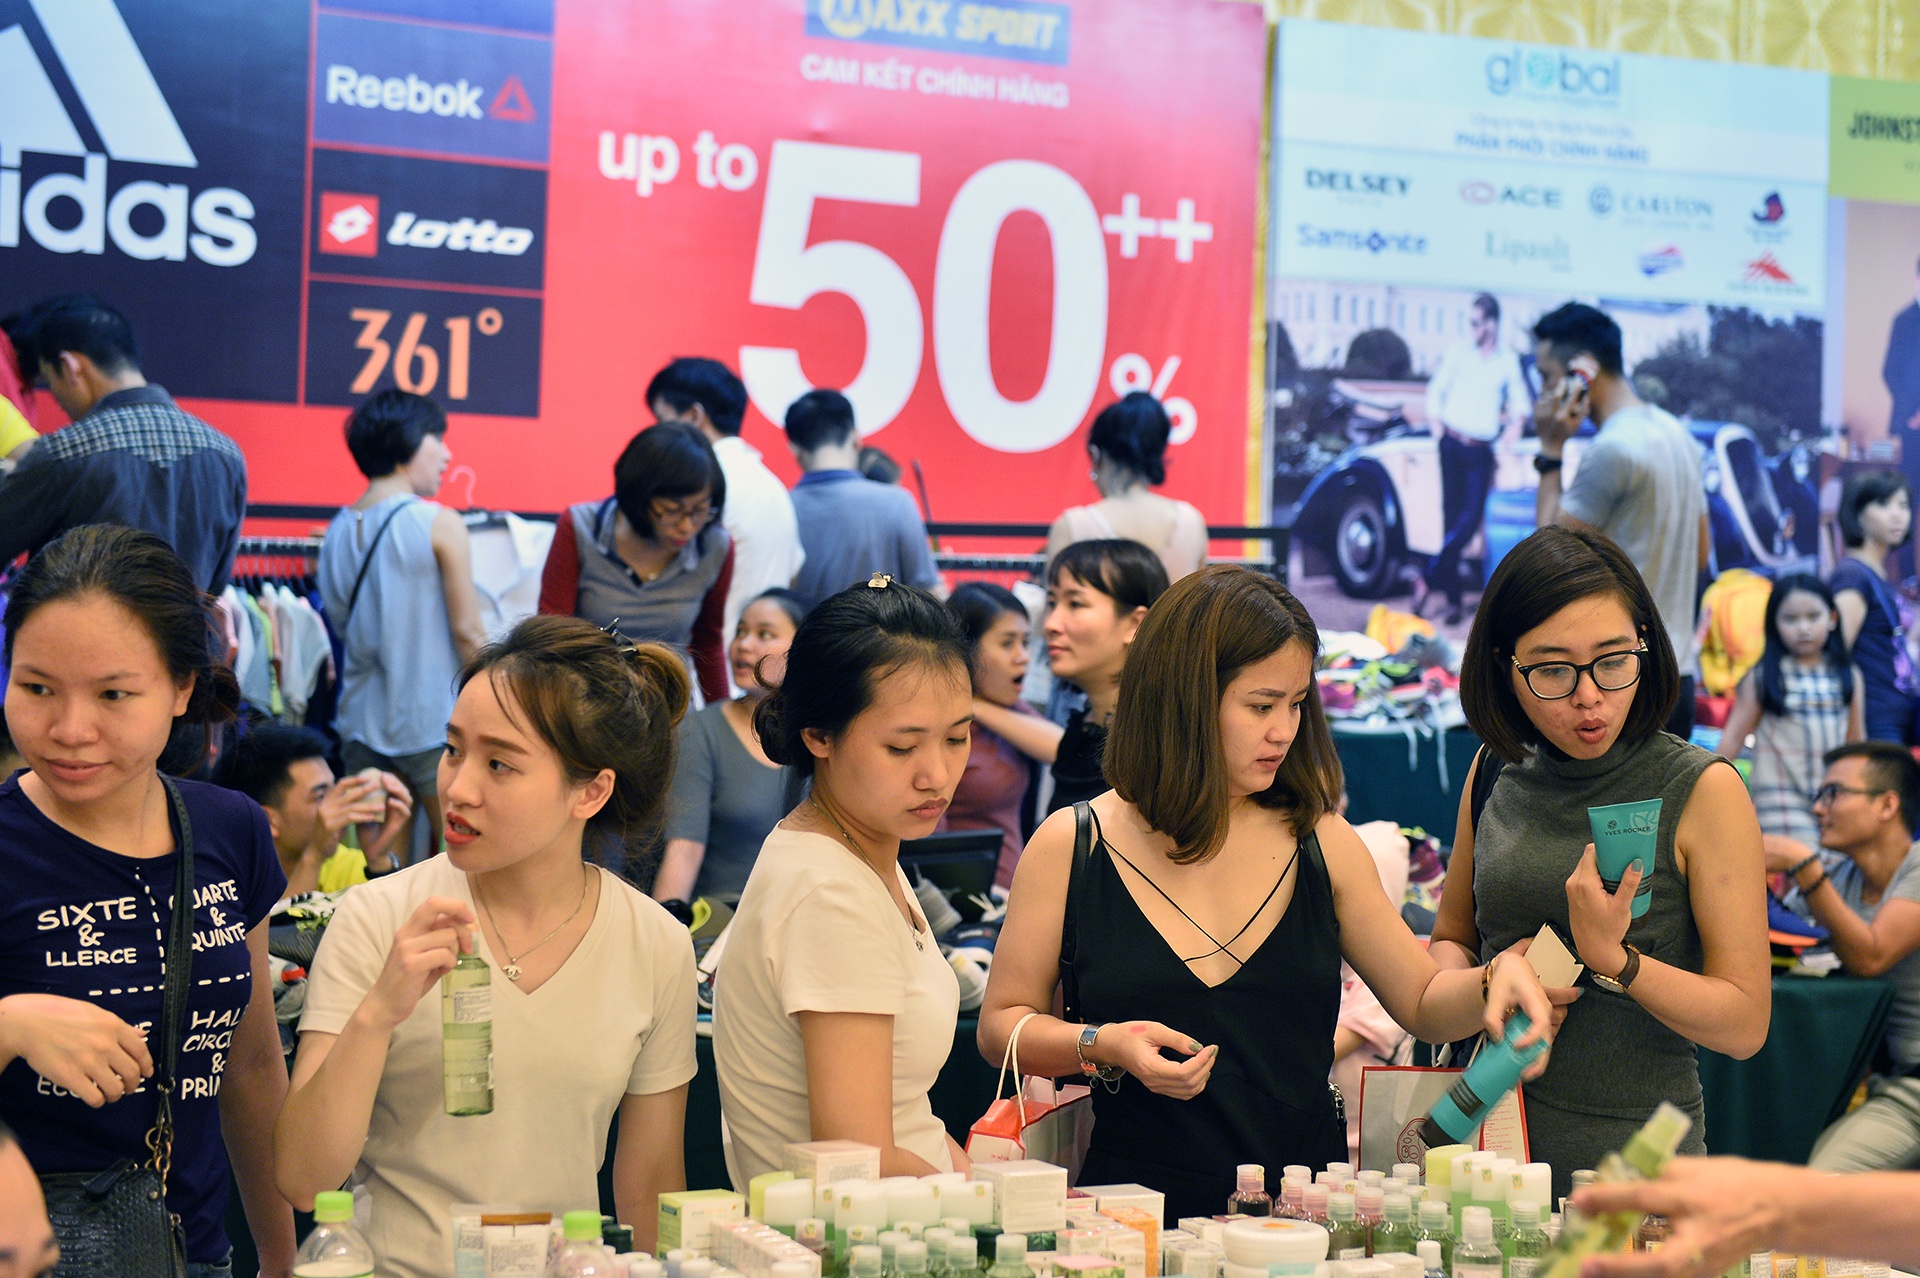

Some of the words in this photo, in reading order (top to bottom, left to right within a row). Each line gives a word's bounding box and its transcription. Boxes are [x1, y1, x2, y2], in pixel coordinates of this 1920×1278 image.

[955, 4, 1060, 50] SPORT
[801, 53, 859, 85] CAM
[1484, 48, 1621, 97] global
[325, 64, 483, 120] Reebok
[1304, 167, 1412, 197] DELSEY
[1501, 187, 1563, 208] ACE
[598, 130, 680, 197] up
[693, 130, 759, 191] to
[738, 138, 1110, 454] 50
[1623, 826, 1652, 834] ROCHER
[37, 896, 137, 931] SIXTE
[209, 906, 227, 927] &
[78, 923, 105, 948] &
[46, 947, 137, 967] LLERCE
[190, 1004, 249, 1030] HAL
[211, 1051, 227, 1074] &
